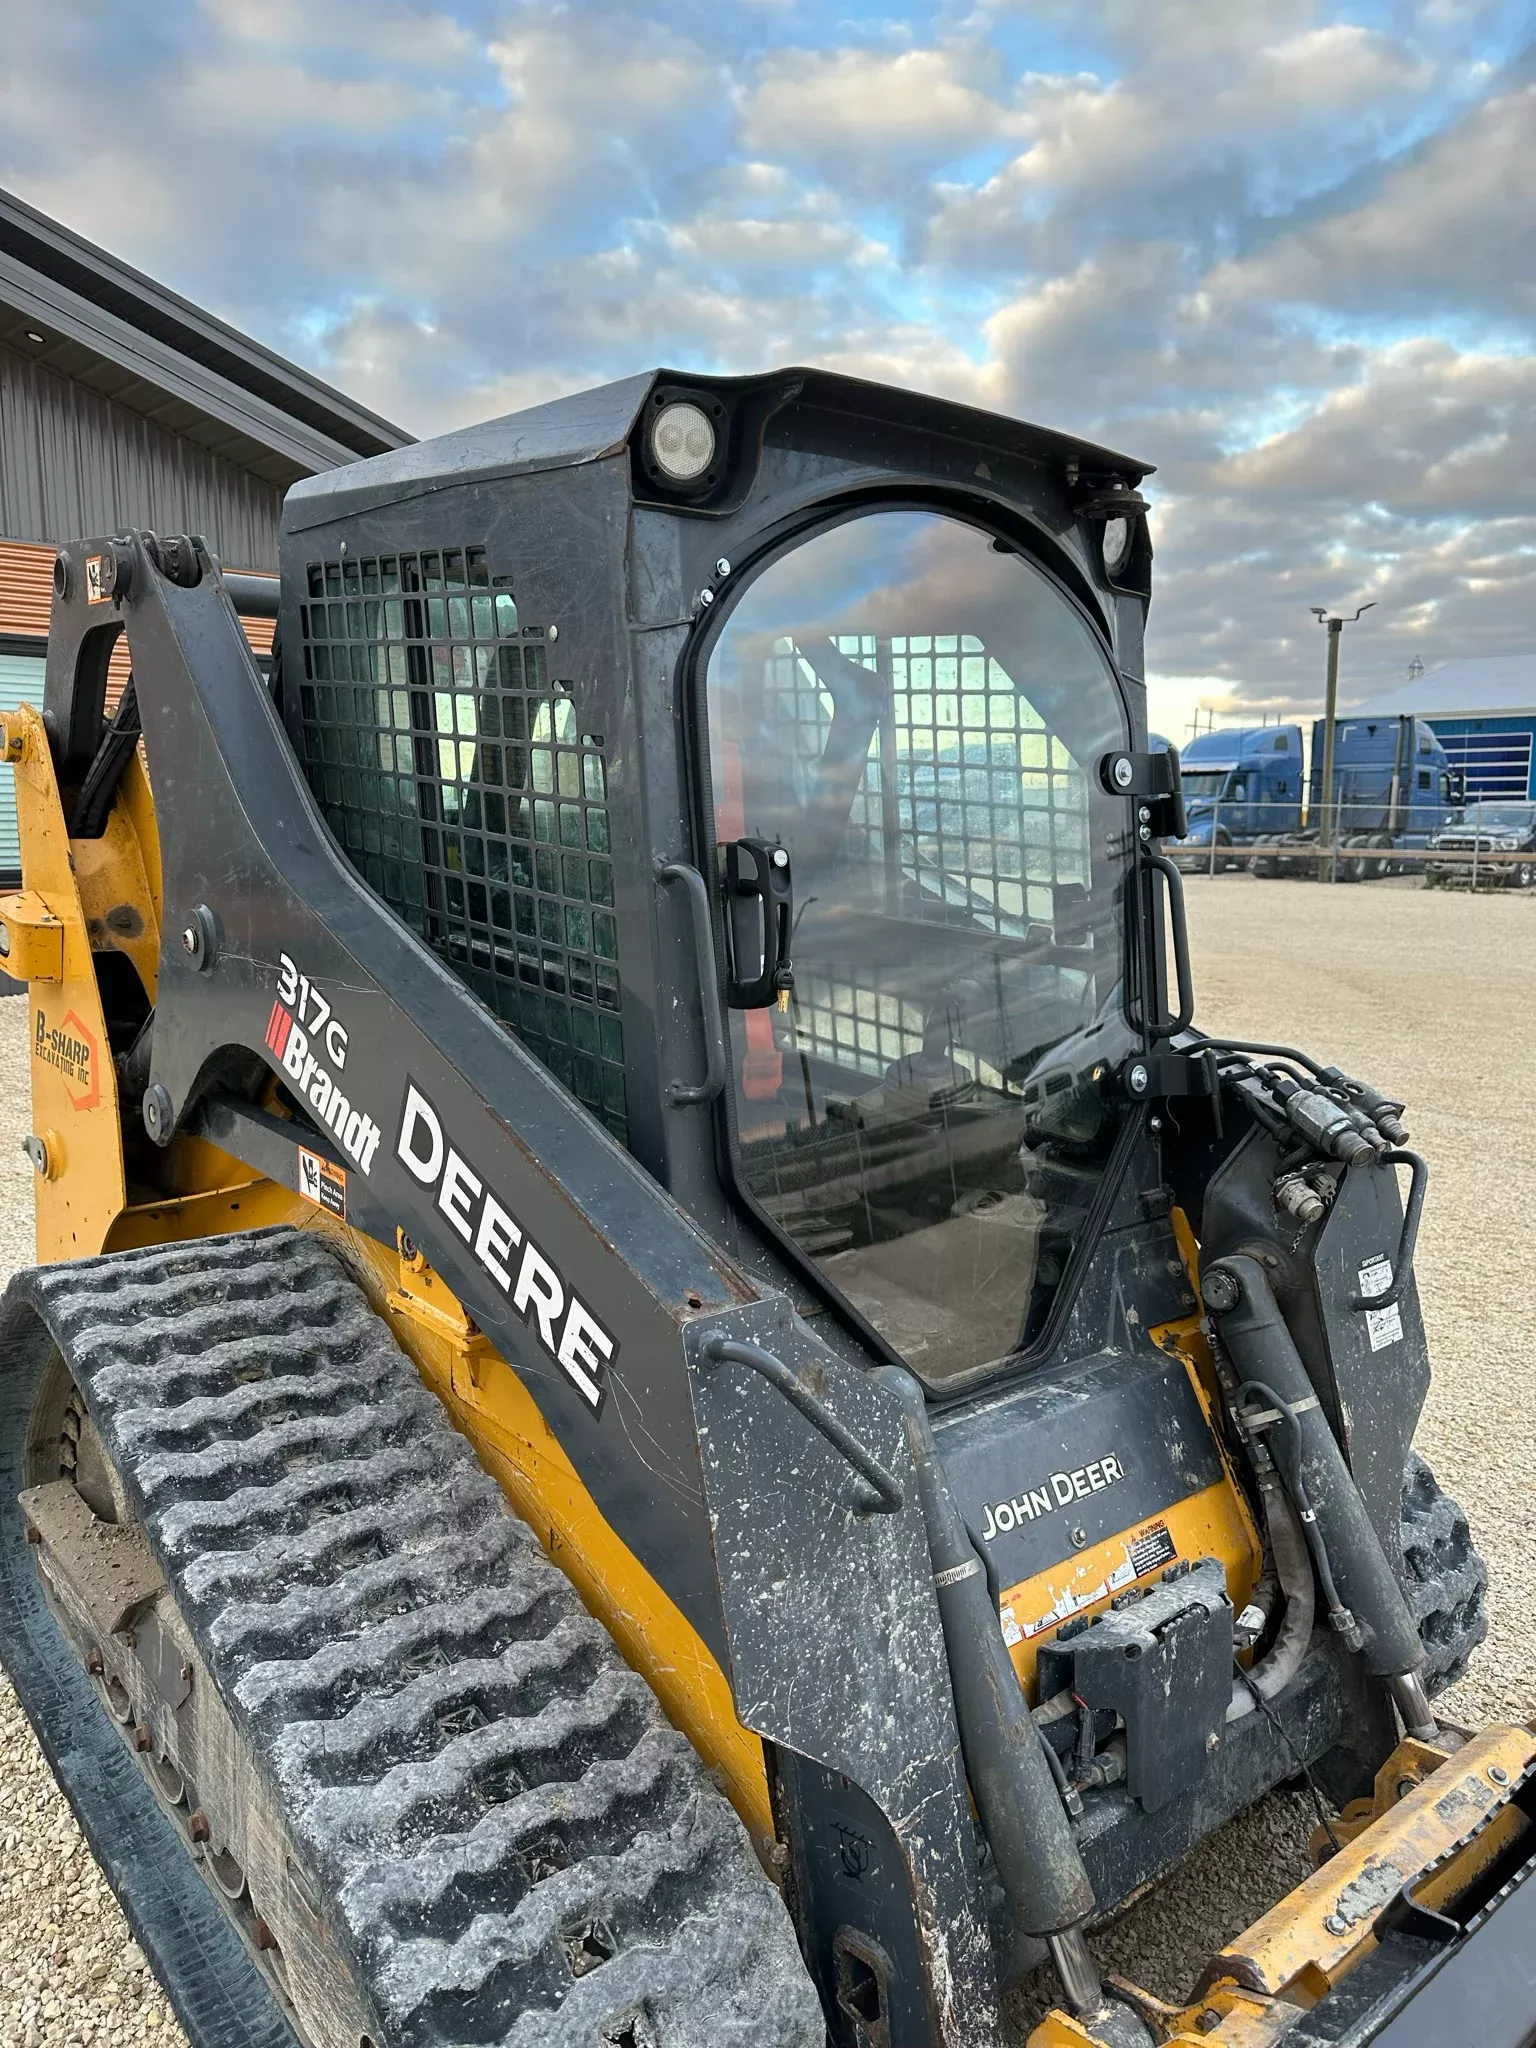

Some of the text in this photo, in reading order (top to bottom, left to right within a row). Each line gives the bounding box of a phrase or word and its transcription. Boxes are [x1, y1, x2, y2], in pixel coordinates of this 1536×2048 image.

[36, 1009, 90, 1066] B-SHARP
[277, 952, 349, 1069] 317G
[35, 1041, 90, 1086] EXCAVATING INC
[282, 1022, 382, 1176] Brandt
[397, 1084, 614, 1407] DEERE
[983, 1486, 1052, 1541] JOHN
